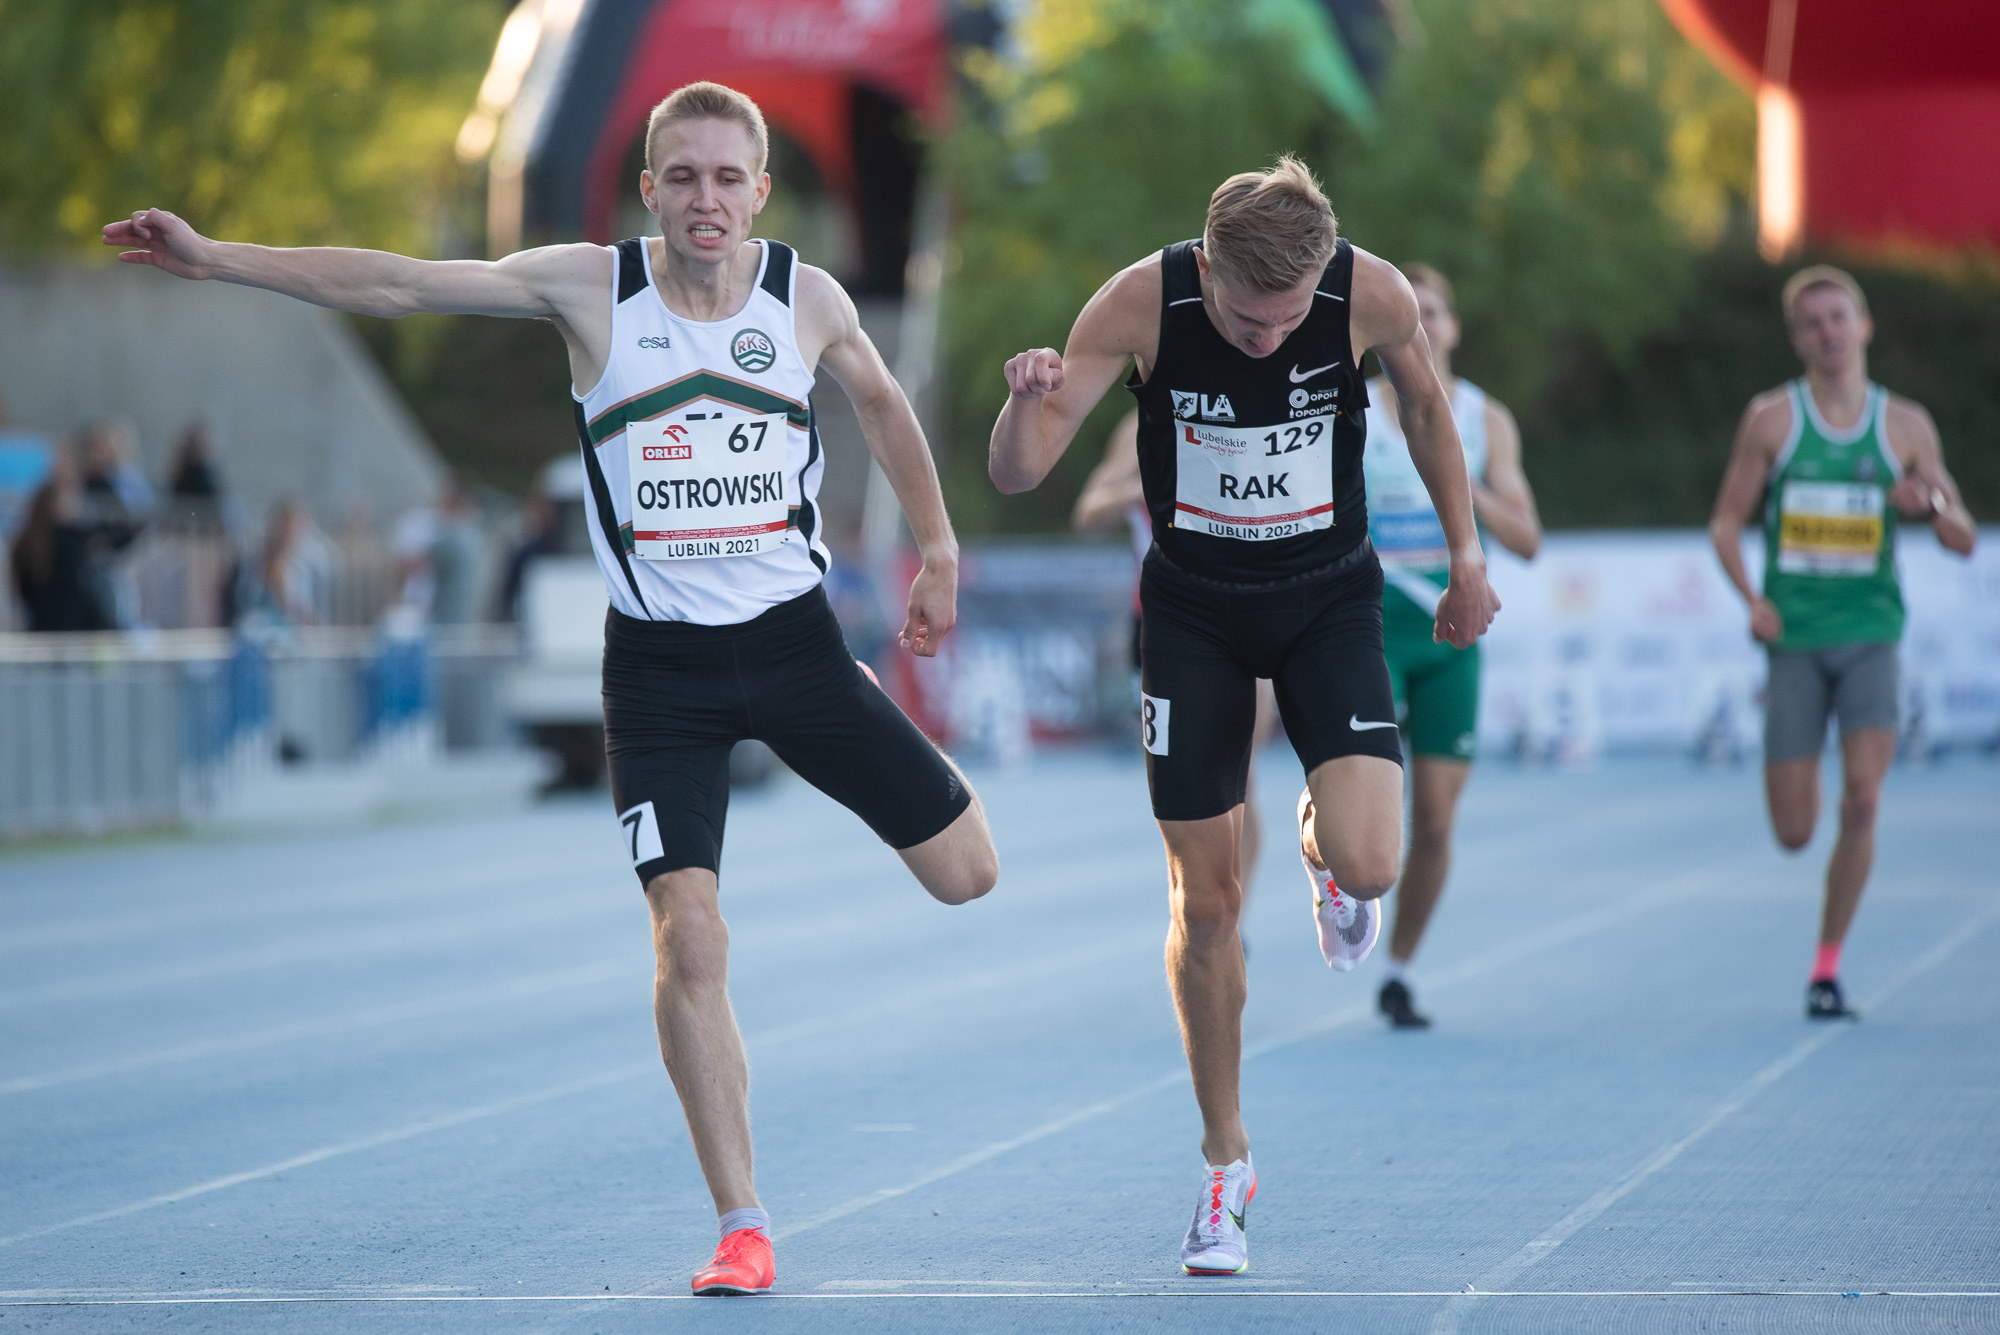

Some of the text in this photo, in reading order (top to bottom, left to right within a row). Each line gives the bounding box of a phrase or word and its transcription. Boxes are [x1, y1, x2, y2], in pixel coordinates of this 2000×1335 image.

[637, 336, 671, 349] esa
[737, 334, 769, 354] RKS
[1310, 390, 1339, 402] OPOLE
[1295, 403, 1338, 418] OPOLSKIE
[728, 421, 768, 454] 67
[1263, 421, 1324, 457] 129
[645, 447, 690, 459] ORLEN
[637, 471, 783, 510] OSTROWSKI
[1219, 472, 1290, 500] RAK
[1208, 522, 1300, 539] LUBLIN 2021
[668, 538, 760, 558] LUBLIN 2021
[1144, 698, 1157, 748] 8
[622, 810, 643, 861] 7
